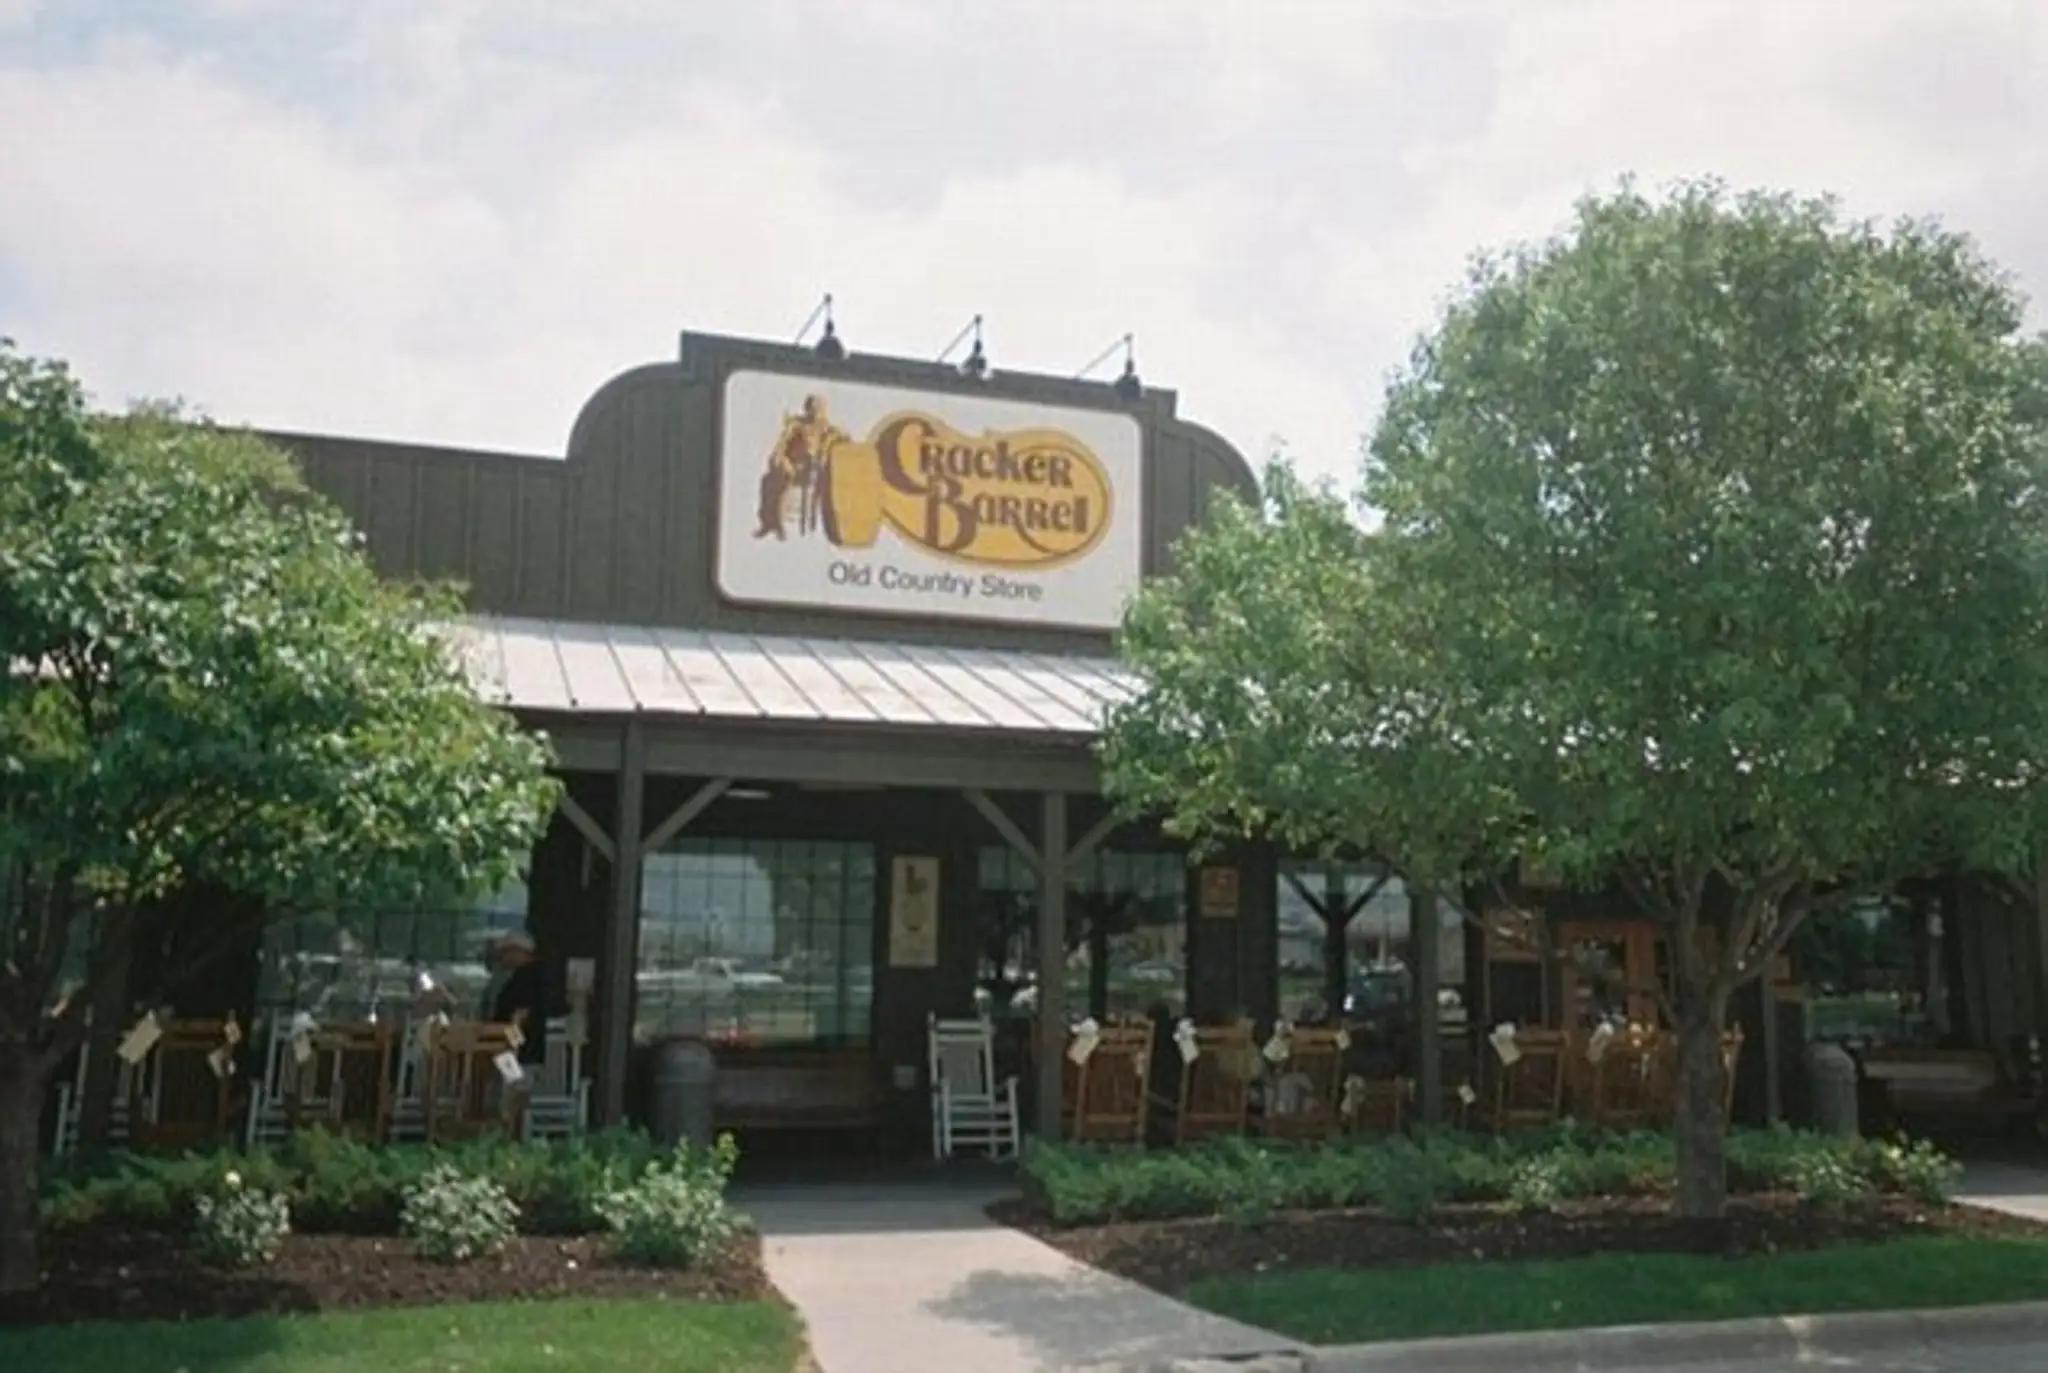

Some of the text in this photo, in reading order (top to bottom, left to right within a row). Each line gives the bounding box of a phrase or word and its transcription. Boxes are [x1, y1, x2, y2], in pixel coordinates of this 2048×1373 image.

[875, 416, 1074, 494] Cracker
[924, 473, 1089, 553] Barrel
[828, 561, 1044, 602] Old Country Store
